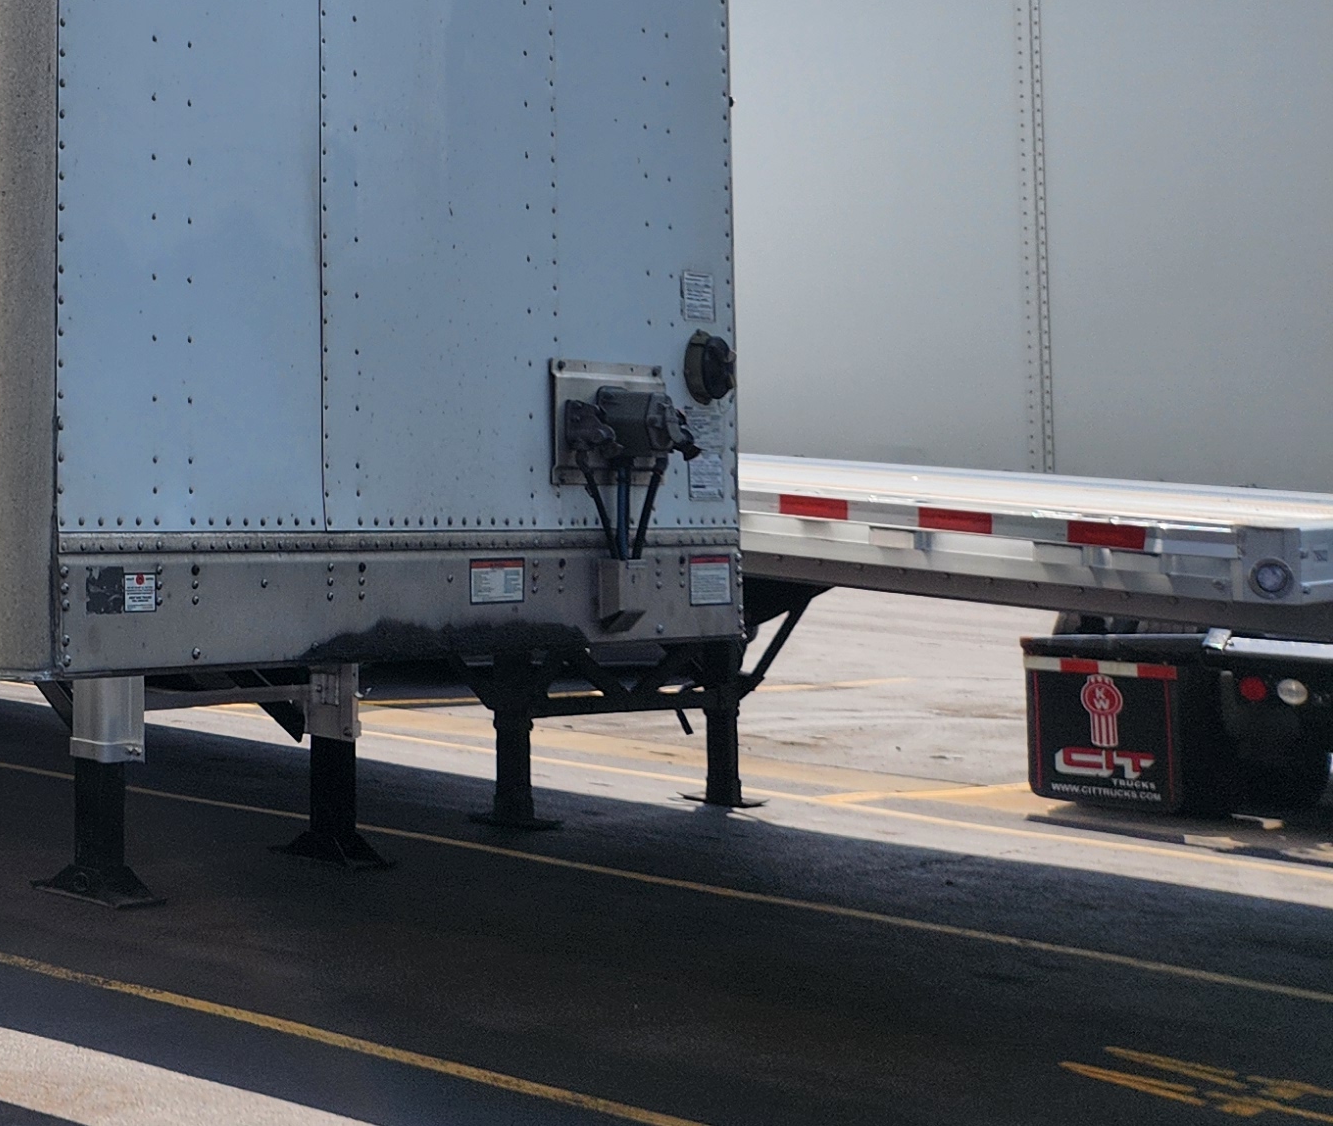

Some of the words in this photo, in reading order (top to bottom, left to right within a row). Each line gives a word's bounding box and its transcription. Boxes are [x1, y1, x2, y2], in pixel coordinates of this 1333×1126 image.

[1054, 747, 1155, 779] CIT
[1051, 783, 1162, 801] WWW.CITTRUCKS.COM
[1112, 778, 1156, 789] TRUCKS
